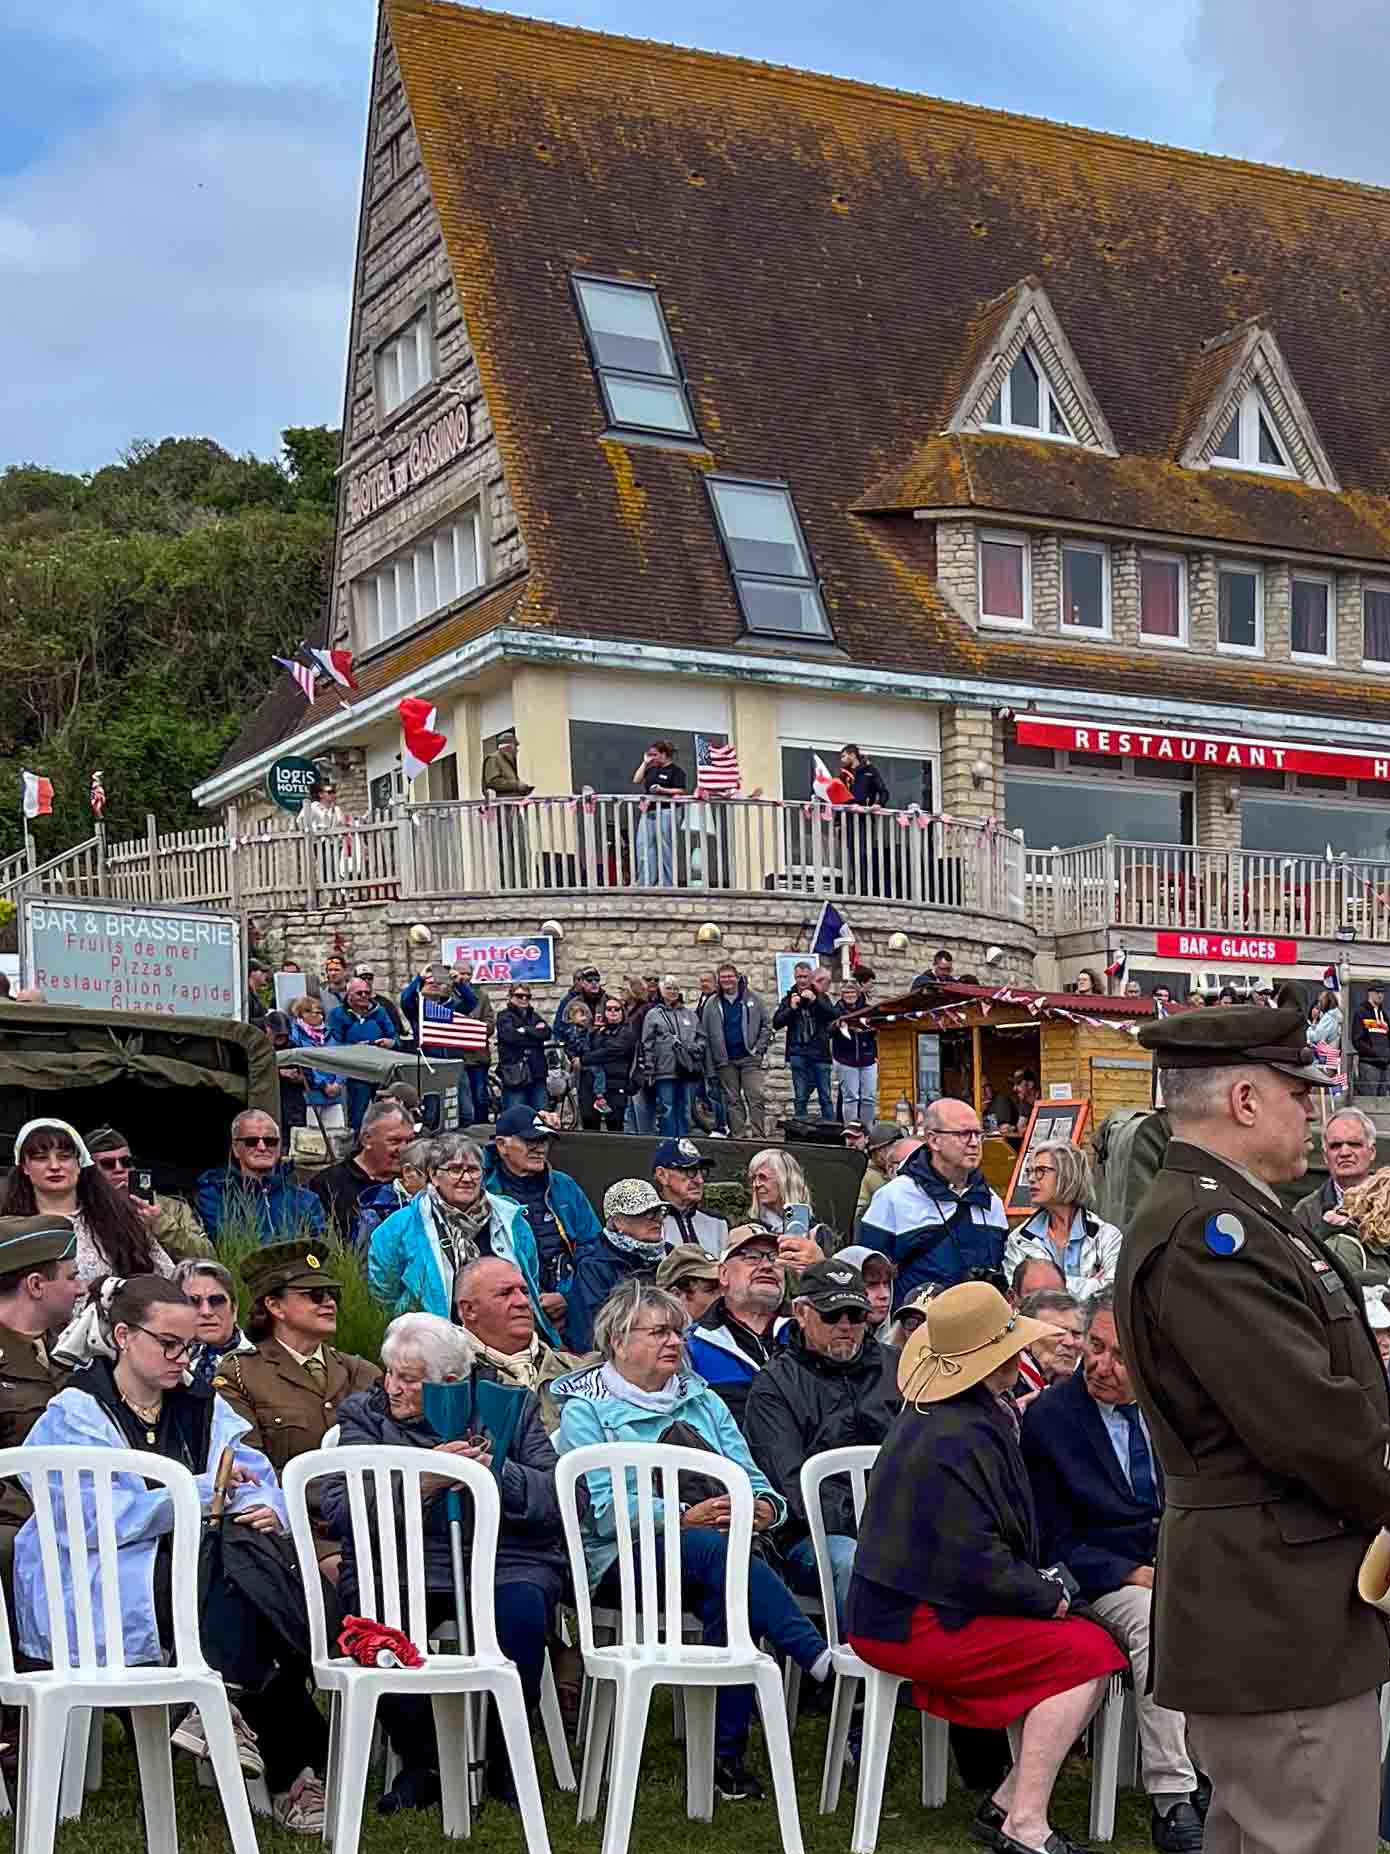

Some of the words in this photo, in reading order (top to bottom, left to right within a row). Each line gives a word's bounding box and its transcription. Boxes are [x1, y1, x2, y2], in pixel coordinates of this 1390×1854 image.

[352, 459, 393, 516] HOTEL
[409, 403, 468, 480] CASINO
[1075, 729, 1285, 767] RESTAURANT
[32, 911, 78, 932] BAR
[85, 913, 99, 934] &
[106, 916, 231, 945] BRASSERIE
[65, 933, 123, 954] Fruits
[134, 940, 154, 956] de
[166, 945, 199, 960] mer
[1179, 936, 1208, 955] BAR
[1221, 939, 1276, 960] GLACES
[112, 956, 173, 977] Pizzas
[472, 961, 513, 981] AR
[36, 970, 161, 995] Restauration
[172, 983, 232, 1002] rapide
